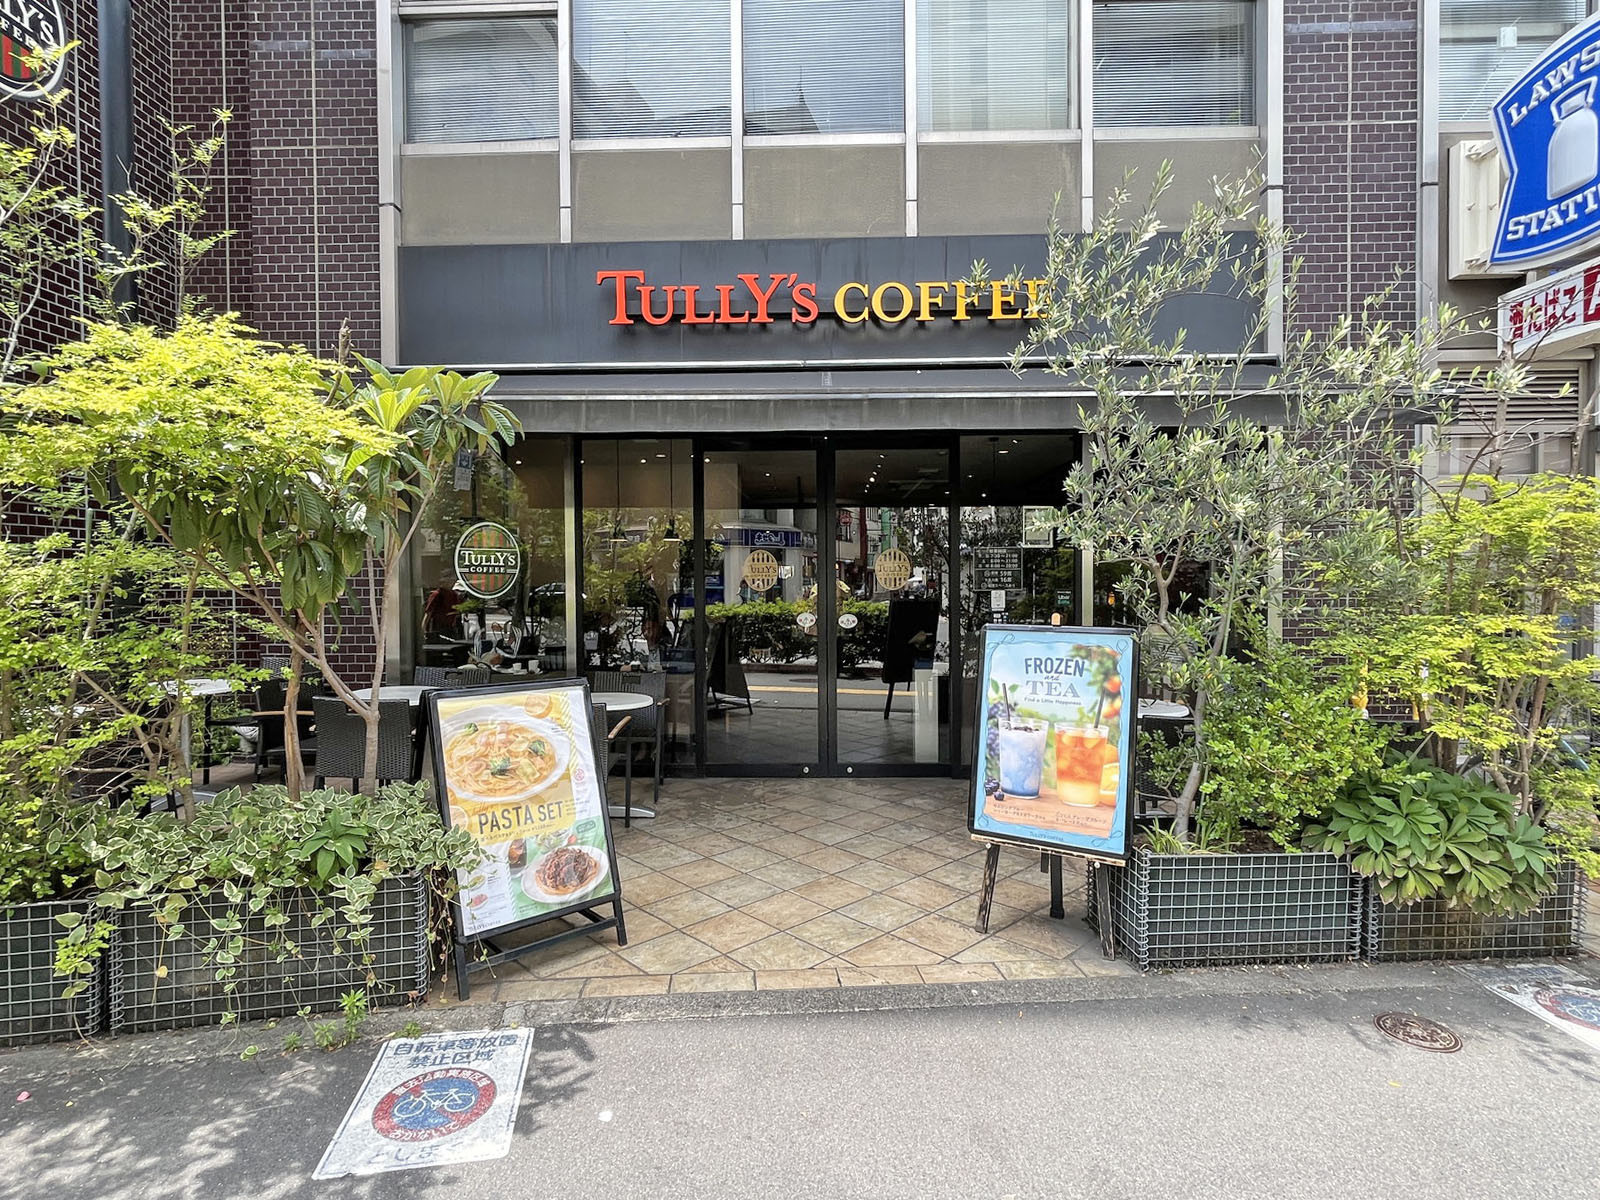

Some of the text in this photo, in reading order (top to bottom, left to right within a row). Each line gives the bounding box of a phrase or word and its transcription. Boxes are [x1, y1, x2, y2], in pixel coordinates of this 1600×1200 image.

[596, 269, 1049, 326] TULLY'S COFFEE
[460, 551, 516, 566] TULLY'S
[1024, 656, 1086, 678] FROZEN
[1025, 680, 1081, 698] TEA
[478, 804, 535, 835] PASTA
[537, 800, 563, 822] SET
[393, 1033, 519, 1056] 自転車等放置
[407, 1049, 496, 1069] 禁止区域
[389, 1119, 461, 1140] おかないで
